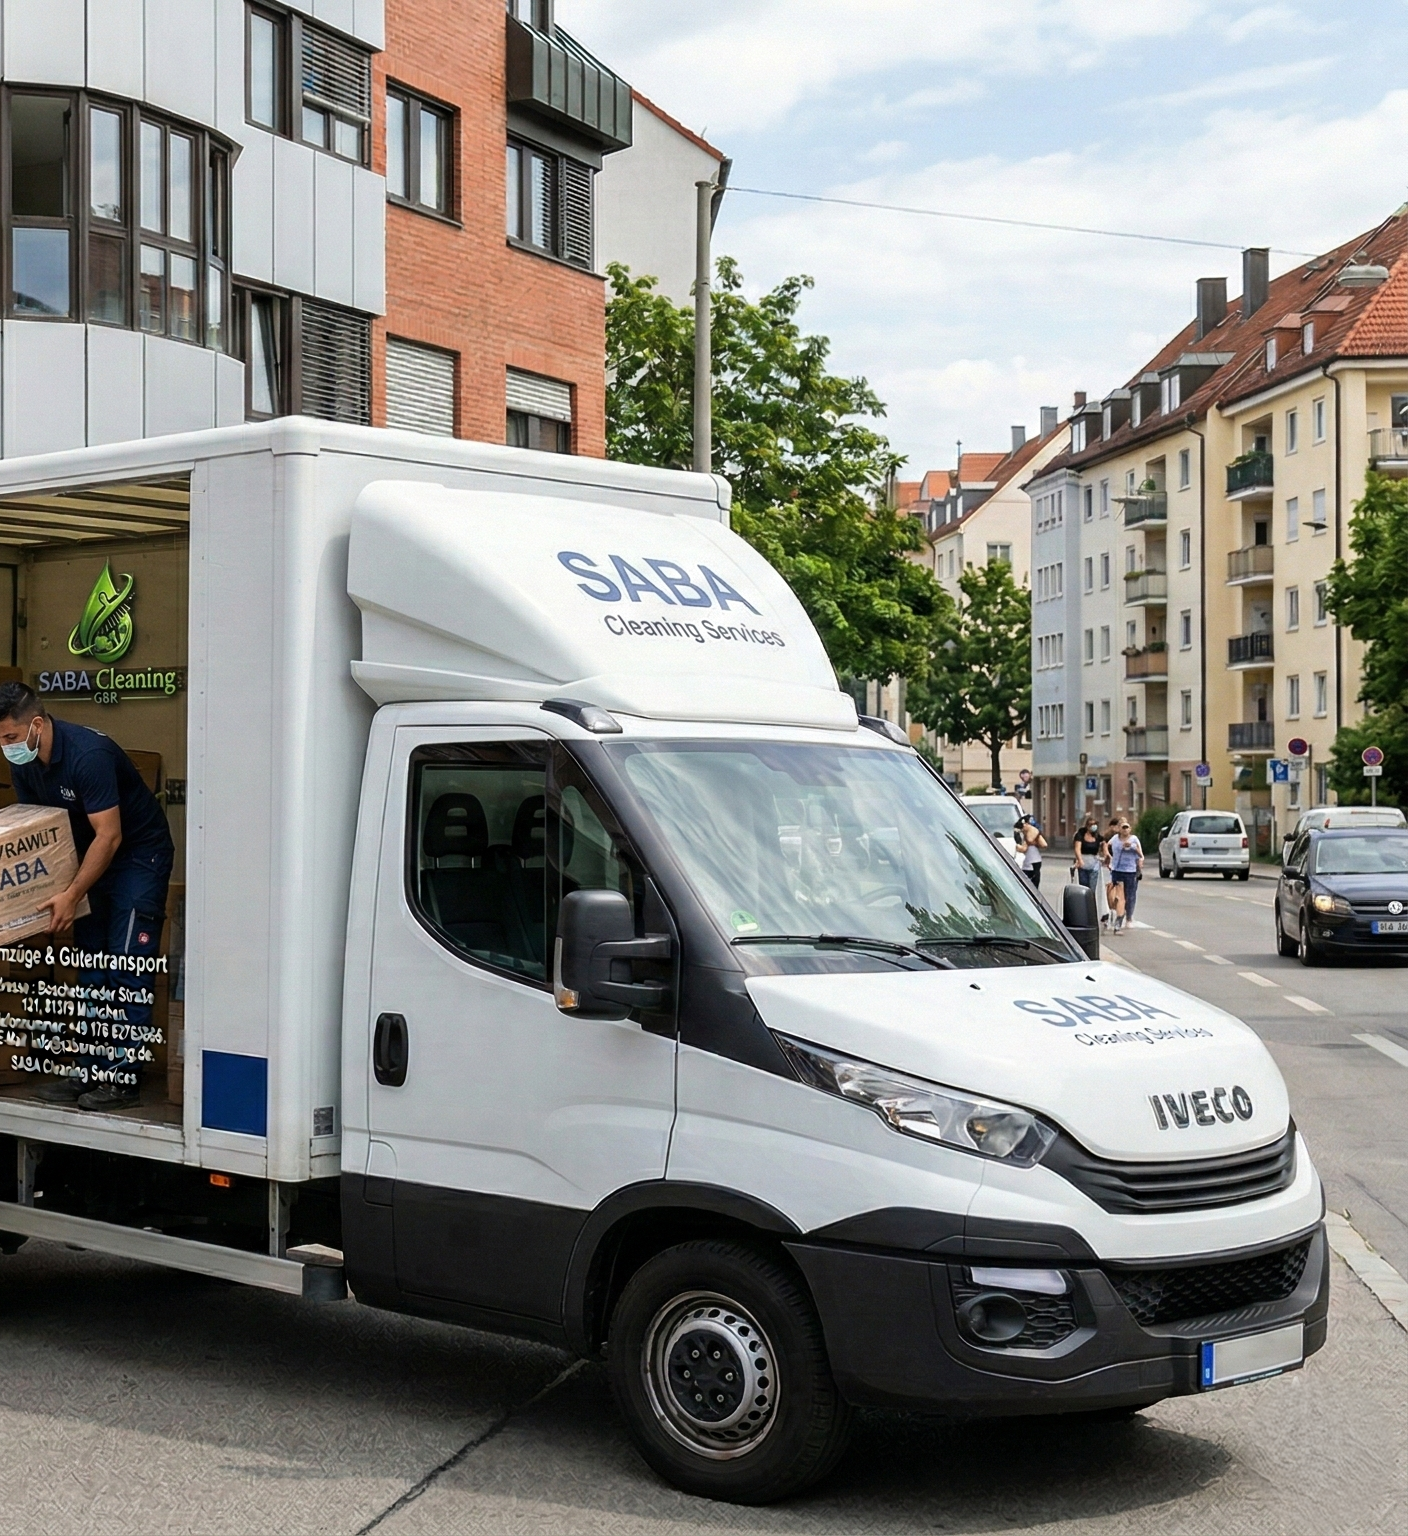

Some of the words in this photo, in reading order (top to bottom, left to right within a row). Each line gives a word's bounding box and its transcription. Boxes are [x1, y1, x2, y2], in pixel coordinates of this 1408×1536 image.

[557, 550, 763, 617] SABA
[604, 614, 706, 644] Cleaning
[702, 619, 786, 648] Services
[39, 670, 90, 691] SABA
[95, 667, 176, 695] Cleaning
[1013, 995, 1181, 1028] SABA
[1148, 1085, 1254, 1131] IVECO
